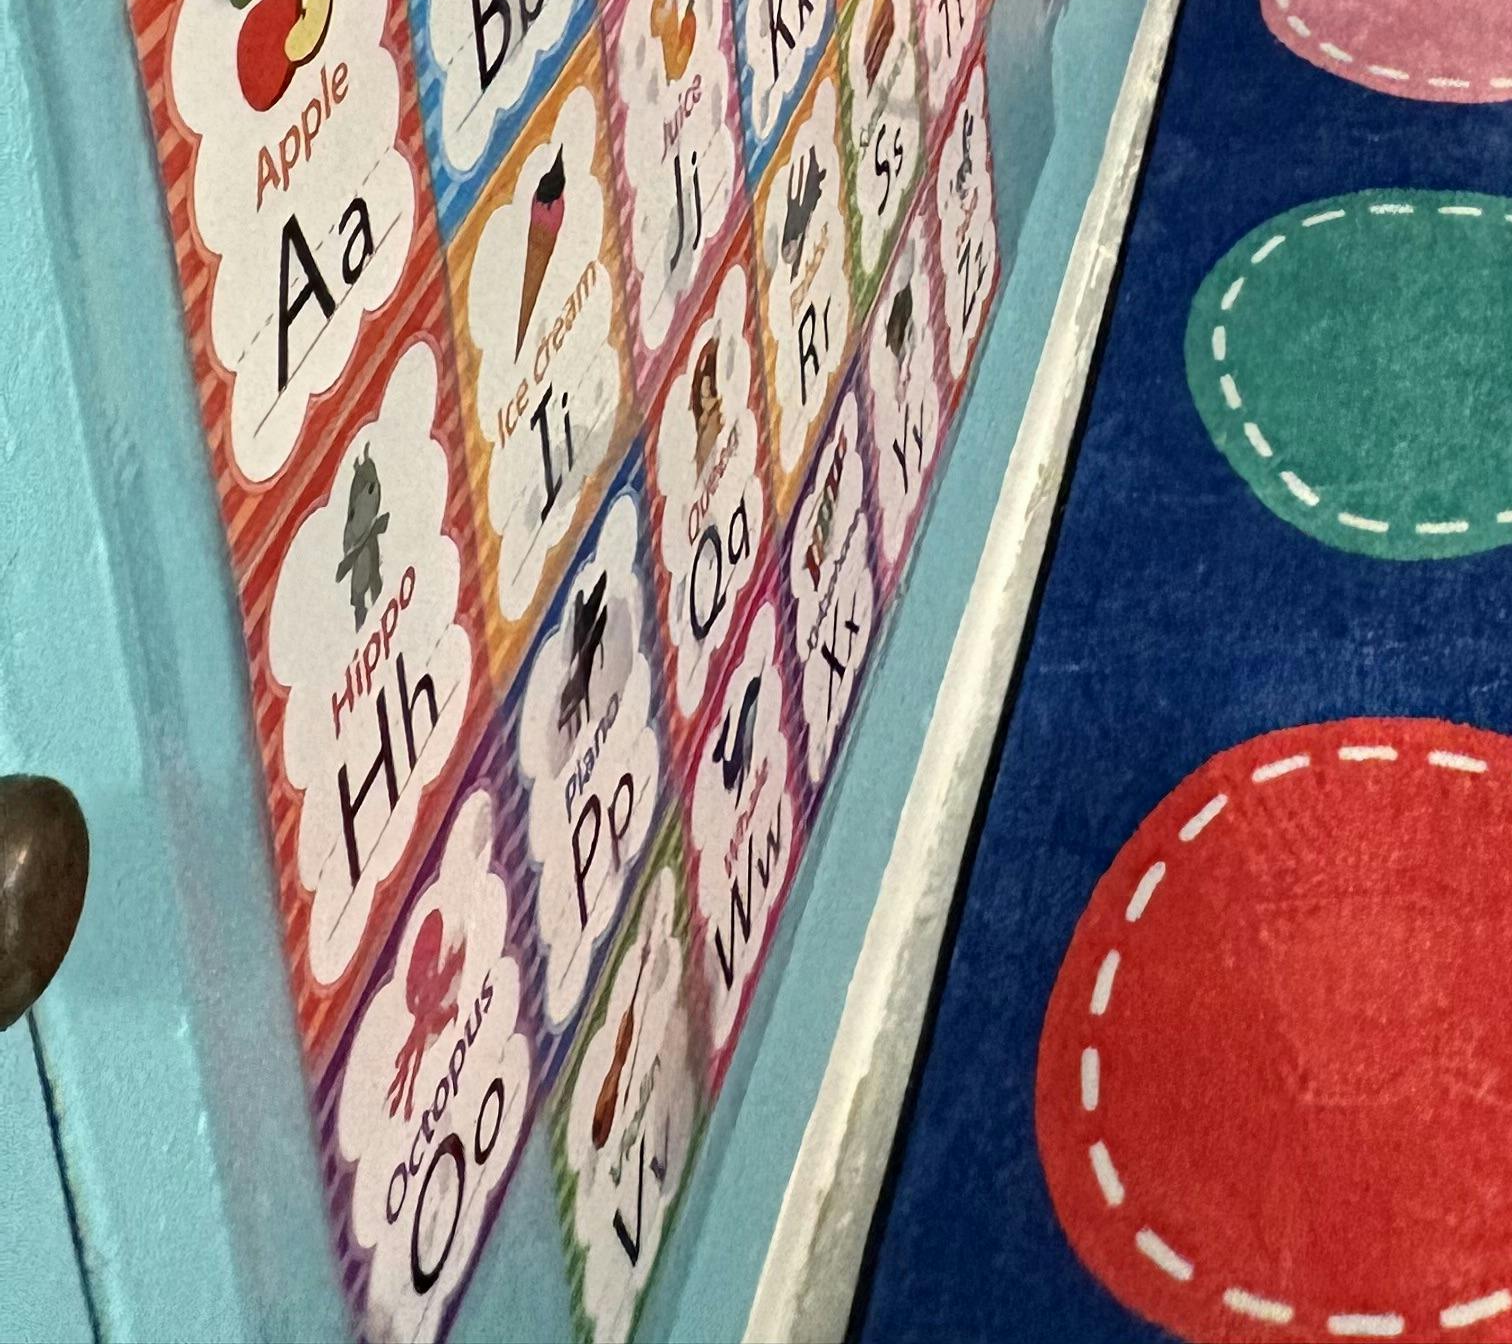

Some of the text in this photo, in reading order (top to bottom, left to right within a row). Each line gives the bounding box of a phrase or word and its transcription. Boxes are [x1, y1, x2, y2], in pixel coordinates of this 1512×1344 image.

[256, 60, 349, 214] Apple
[661, 74, 702, 164] Juice
[278, 197, 375, 394] Aa
[500, 376, 530, 448] Ice
[530, 382, 575, 523] Ii
[690, 495, 751, 641] Qq
[331, 565, 416, 741] Hippo
[337, 651, 439, 889] Hh
[571, 773, 635, 931] Pp
[385, 968, 495, 1226] Octopus
[410, 1076, 504, 1295] Oo
